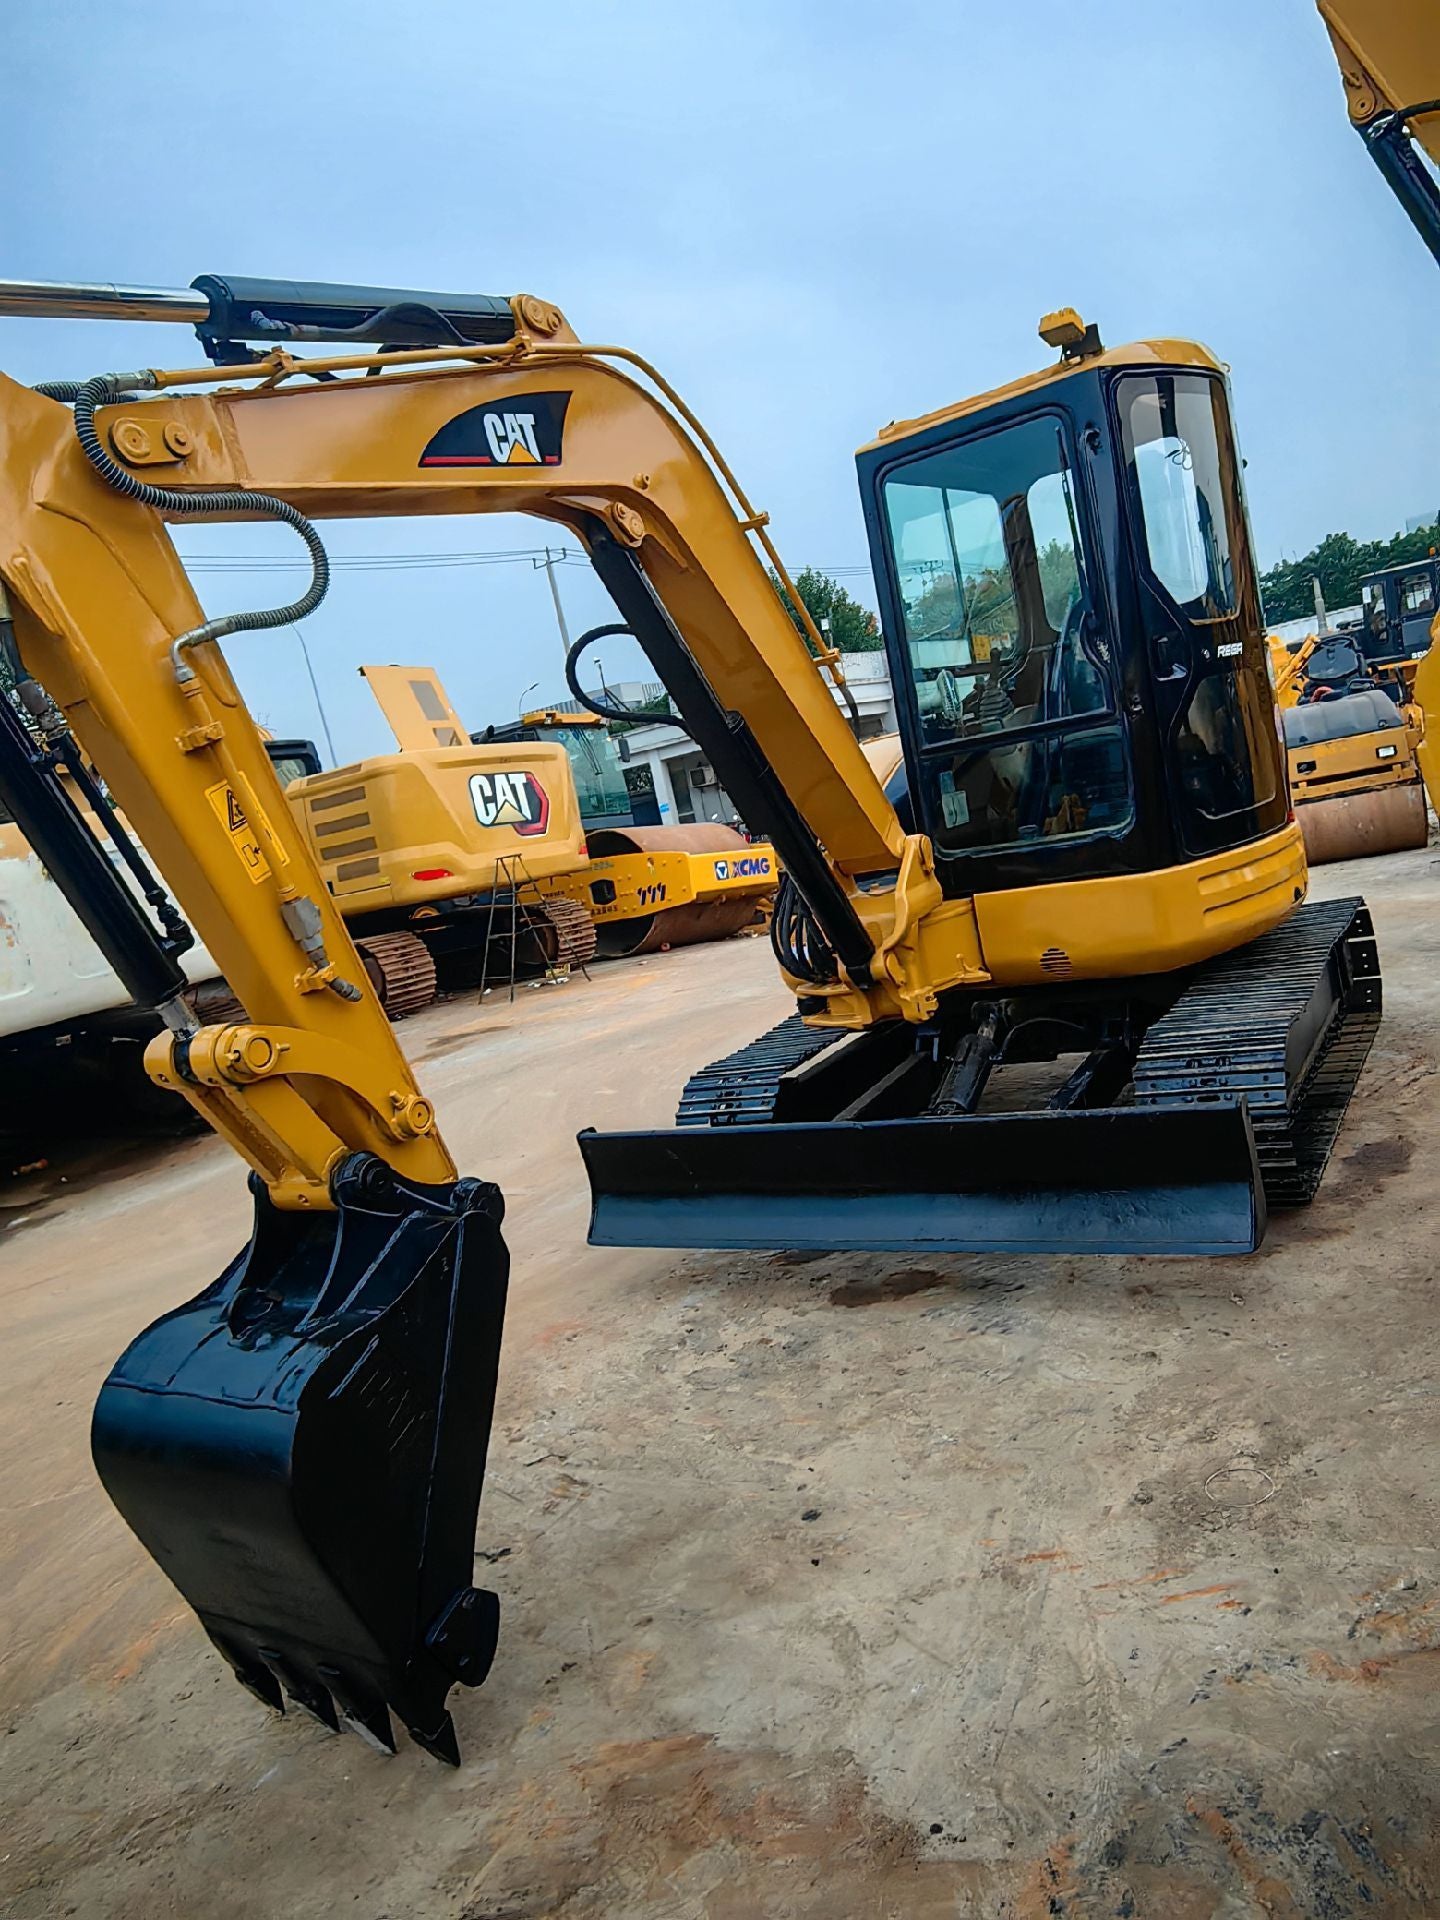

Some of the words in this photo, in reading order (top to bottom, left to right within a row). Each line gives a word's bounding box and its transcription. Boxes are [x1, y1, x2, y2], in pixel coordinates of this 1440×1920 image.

[483, 413, 543, 463] CAT
[470, 773, 532, 824] CAT
[731, 857, 771, 879] XCMG
